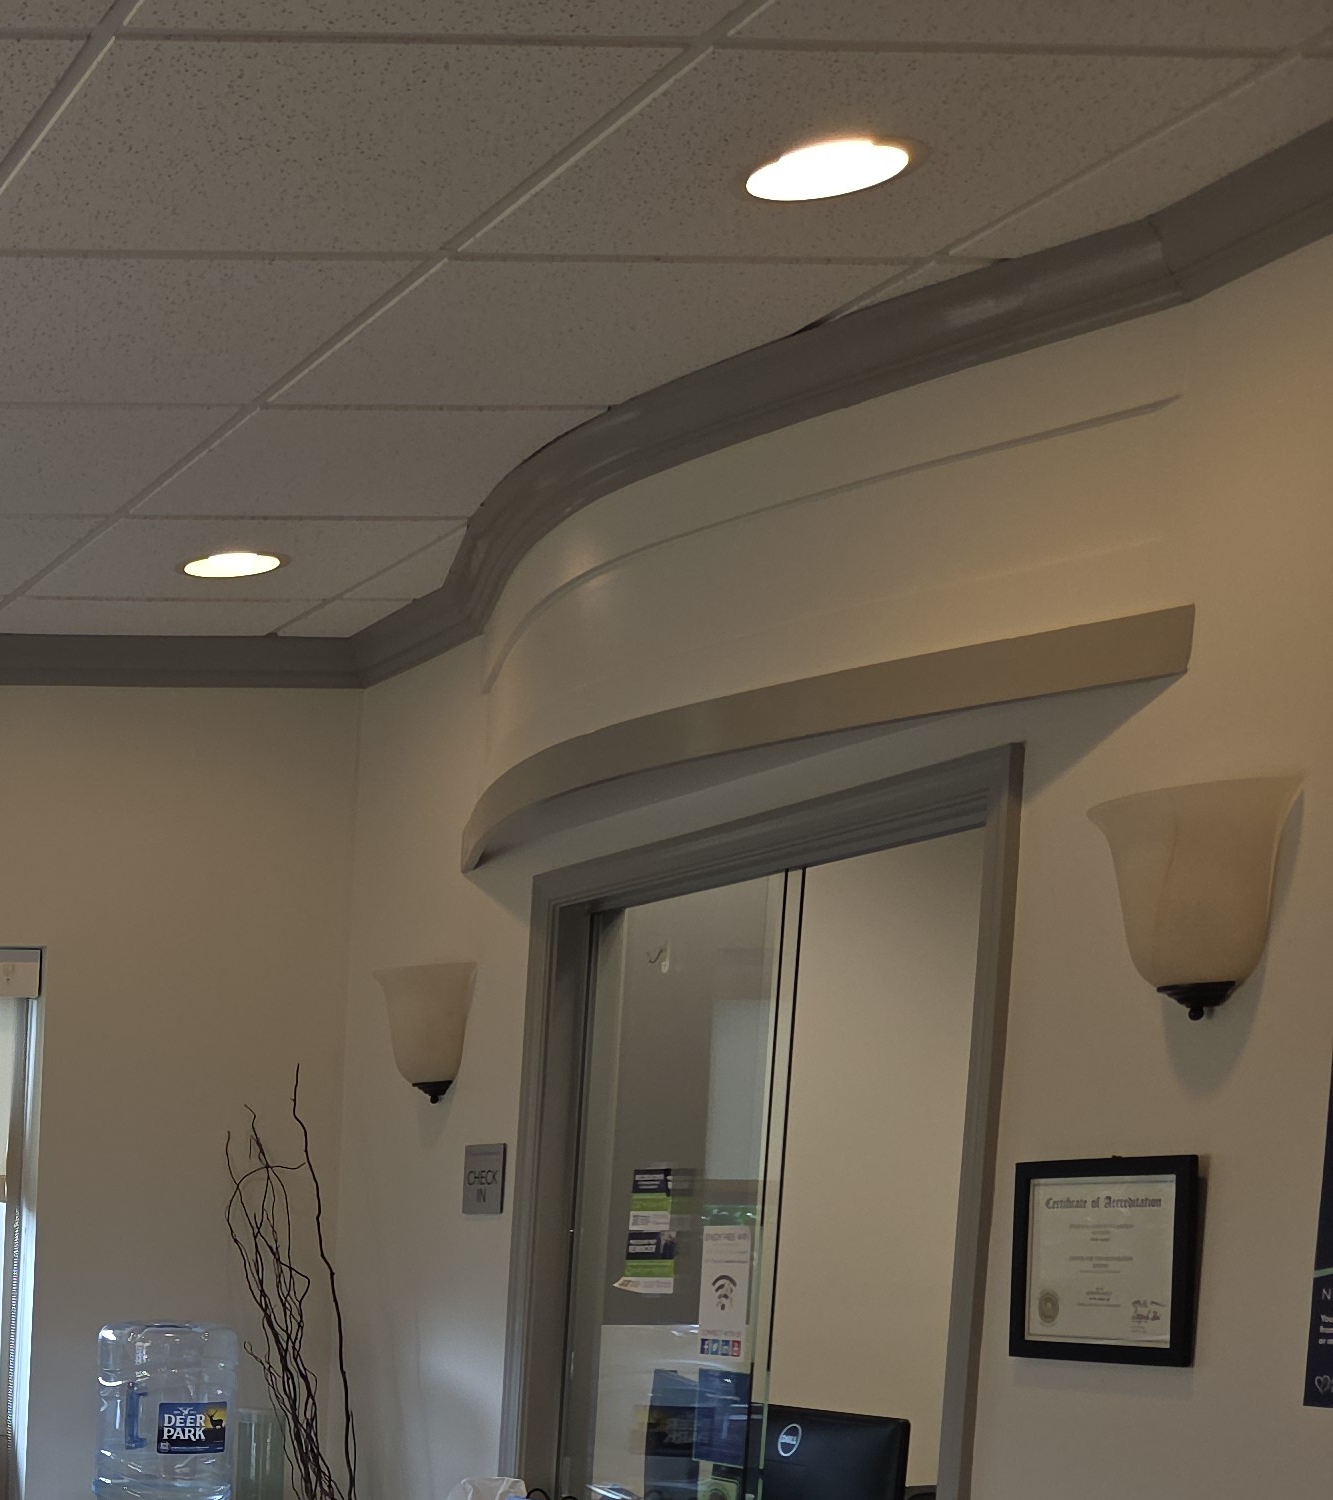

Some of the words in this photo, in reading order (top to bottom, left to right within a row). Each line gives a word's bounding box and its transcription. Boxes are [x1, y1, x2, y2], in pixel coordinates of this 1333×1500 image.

[467, 1170, 499, 1186] CHECK
[476, 1188, 487, 1203] IN
[1091, 1196, 1100, 1208] of
[164, 1414, 205, 1426] DEER
[163, 1427, 205, 1441] PARK
